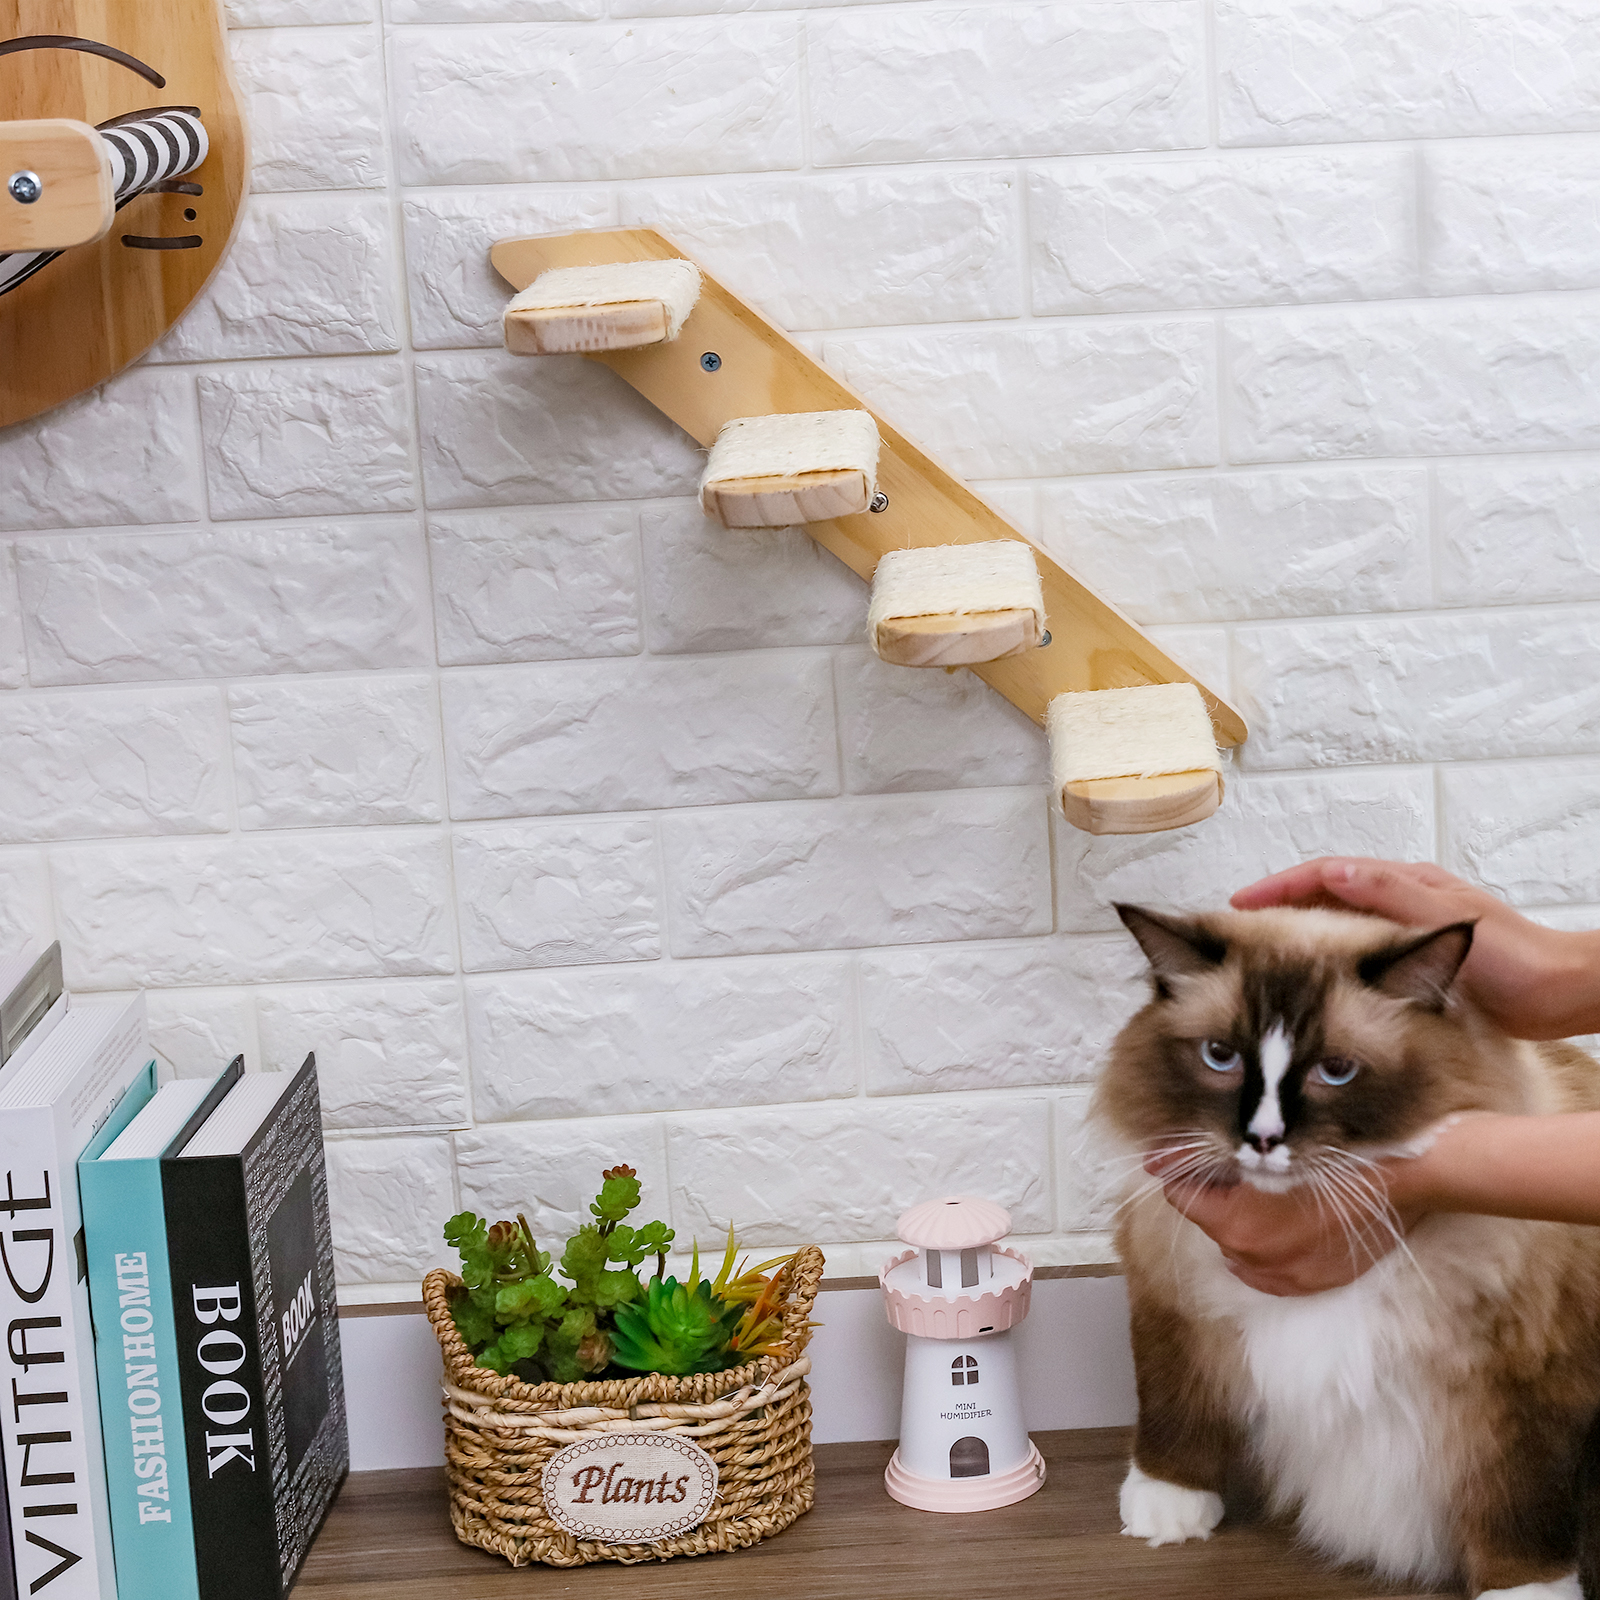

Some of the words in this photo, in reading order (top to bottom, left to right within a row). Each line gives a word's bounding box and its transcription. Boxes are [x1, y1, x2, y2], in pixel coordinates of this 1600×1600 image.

[281, 1269, 316, 1358] BOOK
[0, 1170, 83, 1596] VINTAGE
[192, 1281, 256, 1479] BOOK
[955, 1402, 976, 1411] MINI
[940, 1409, 993, 1421] HUMIDIFIER
[570, 1462, 690, 1505] Plants
